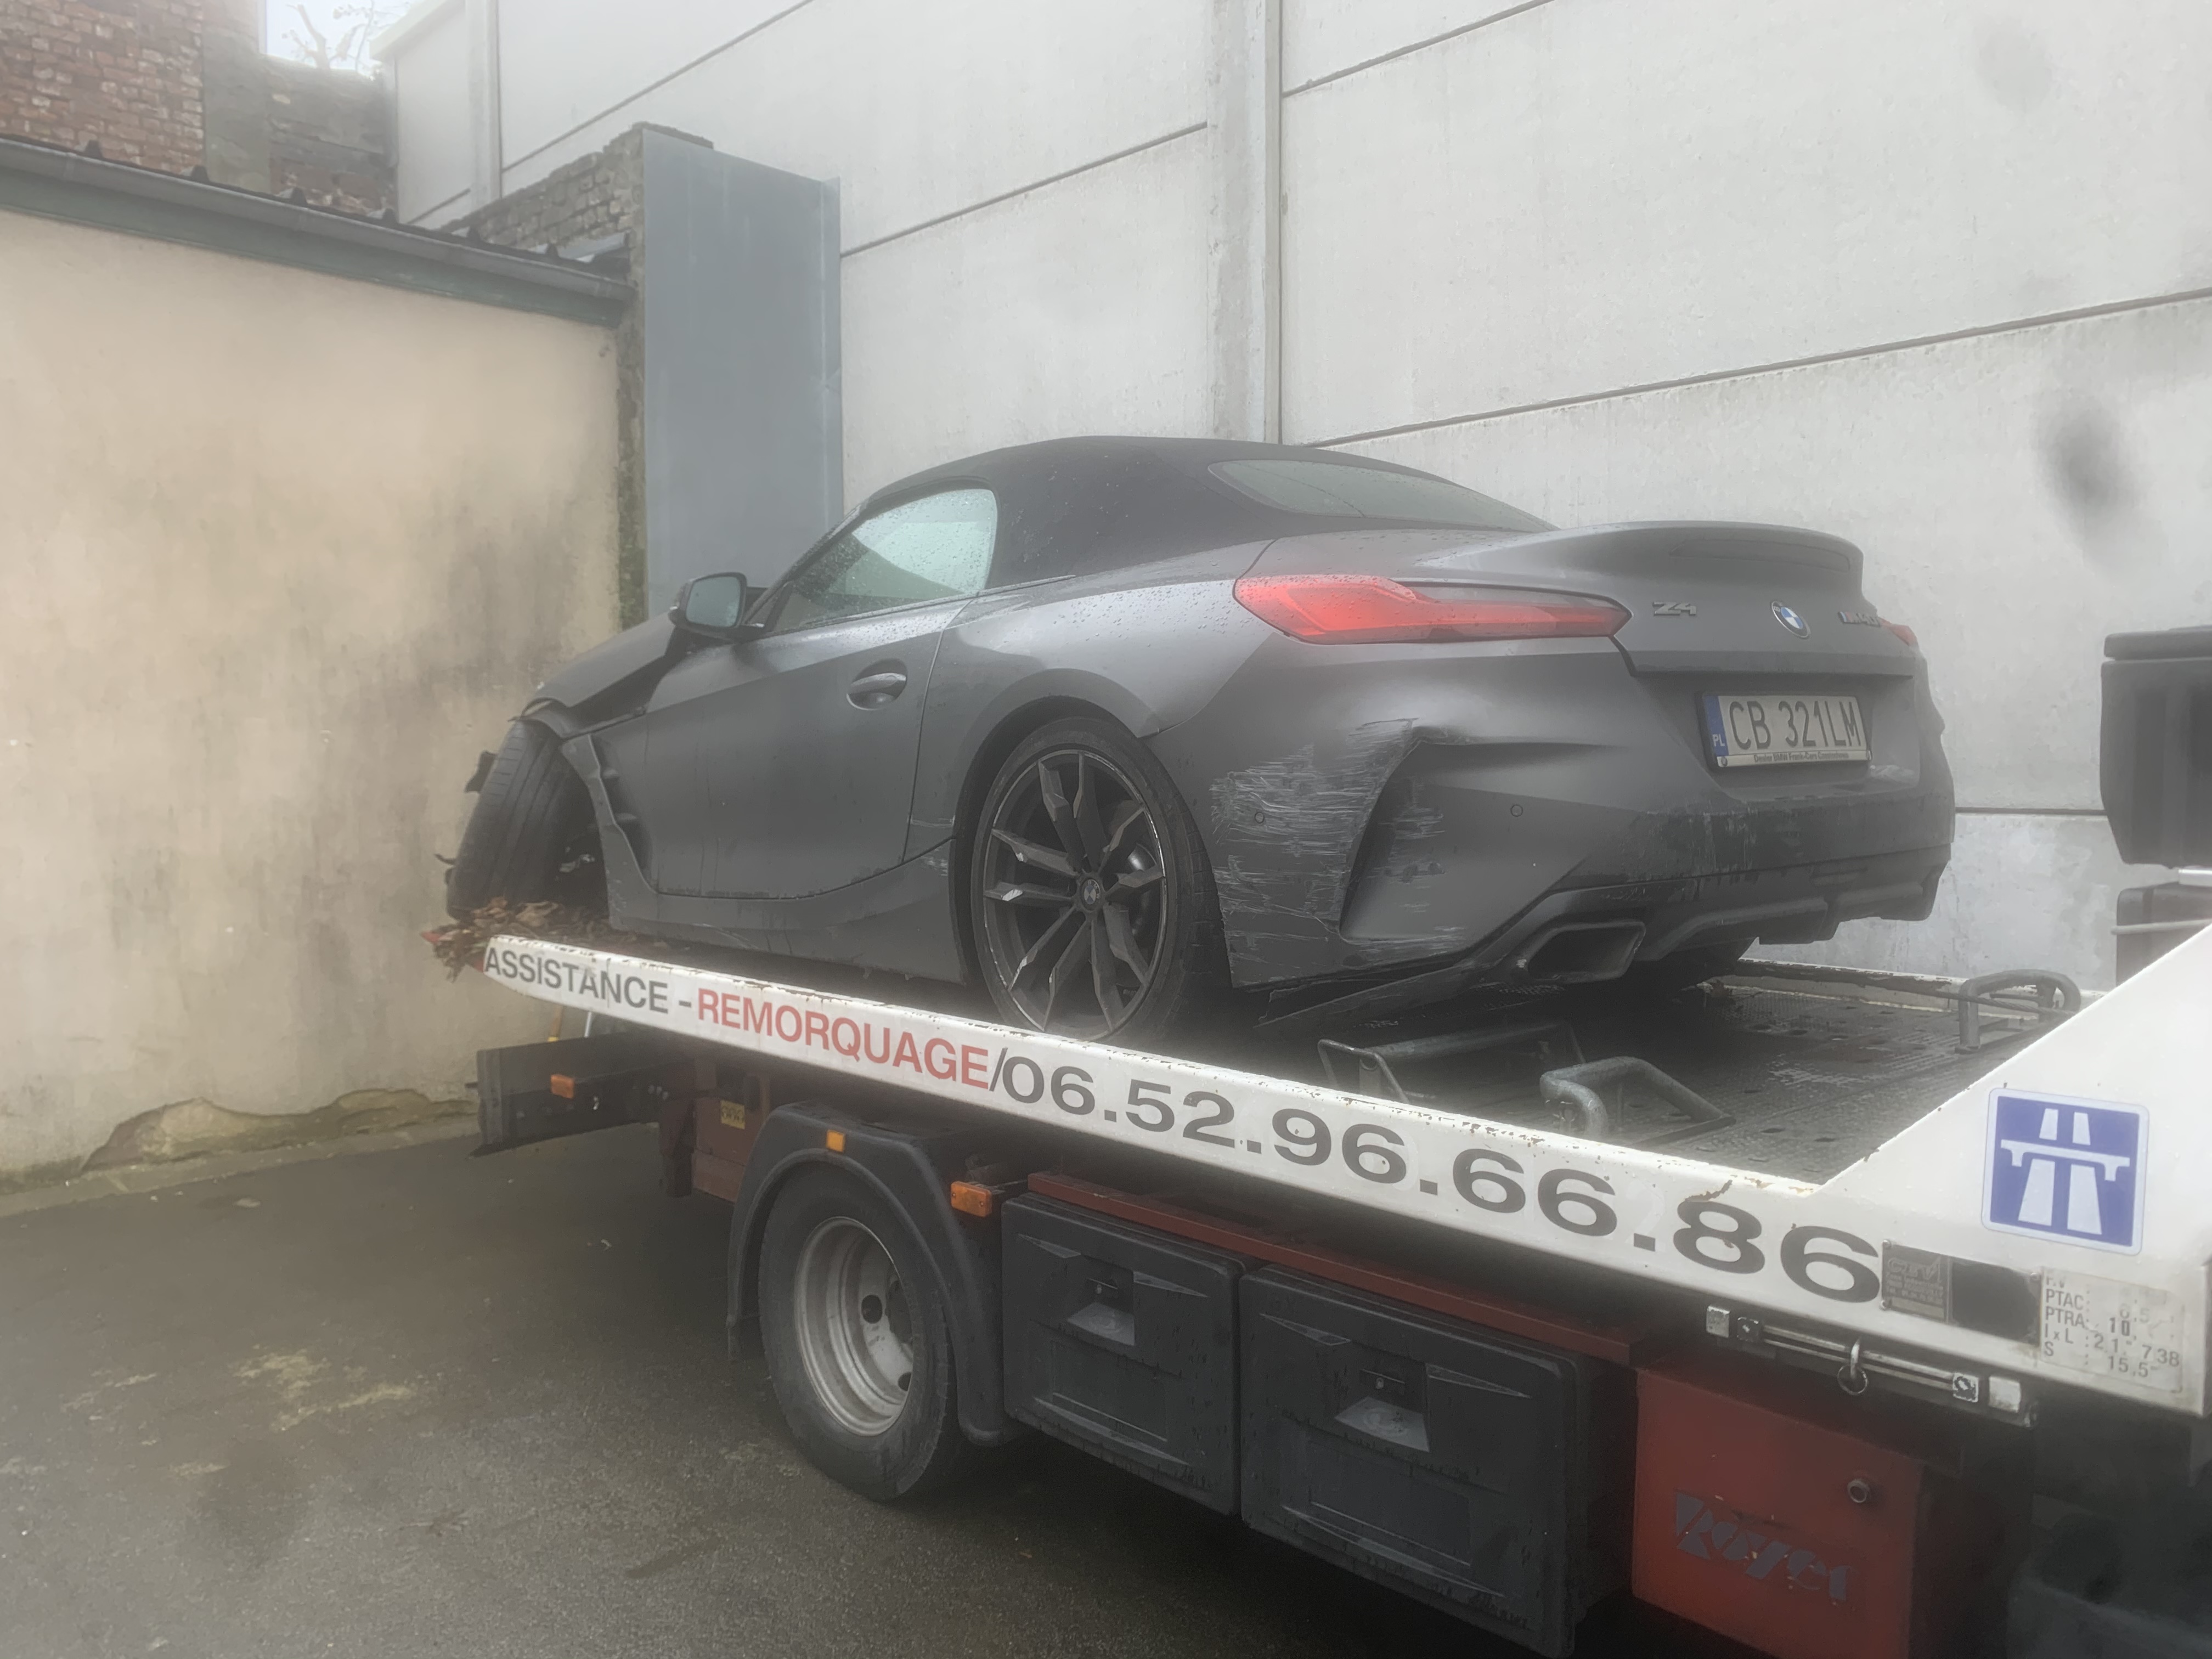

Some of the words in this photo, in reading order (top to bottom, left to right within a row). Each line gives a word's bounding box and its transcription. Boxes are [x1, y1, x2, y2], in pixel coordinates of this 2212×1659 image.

[1652, 601, 1697, 616] Z4
[1712, 733, 1726, 747] PL
[1729, 701, 1771, 750] CB
[1778, 701, 1861, 748] 321LM
[484, 946, 669, 1014] ASSISTANCE
